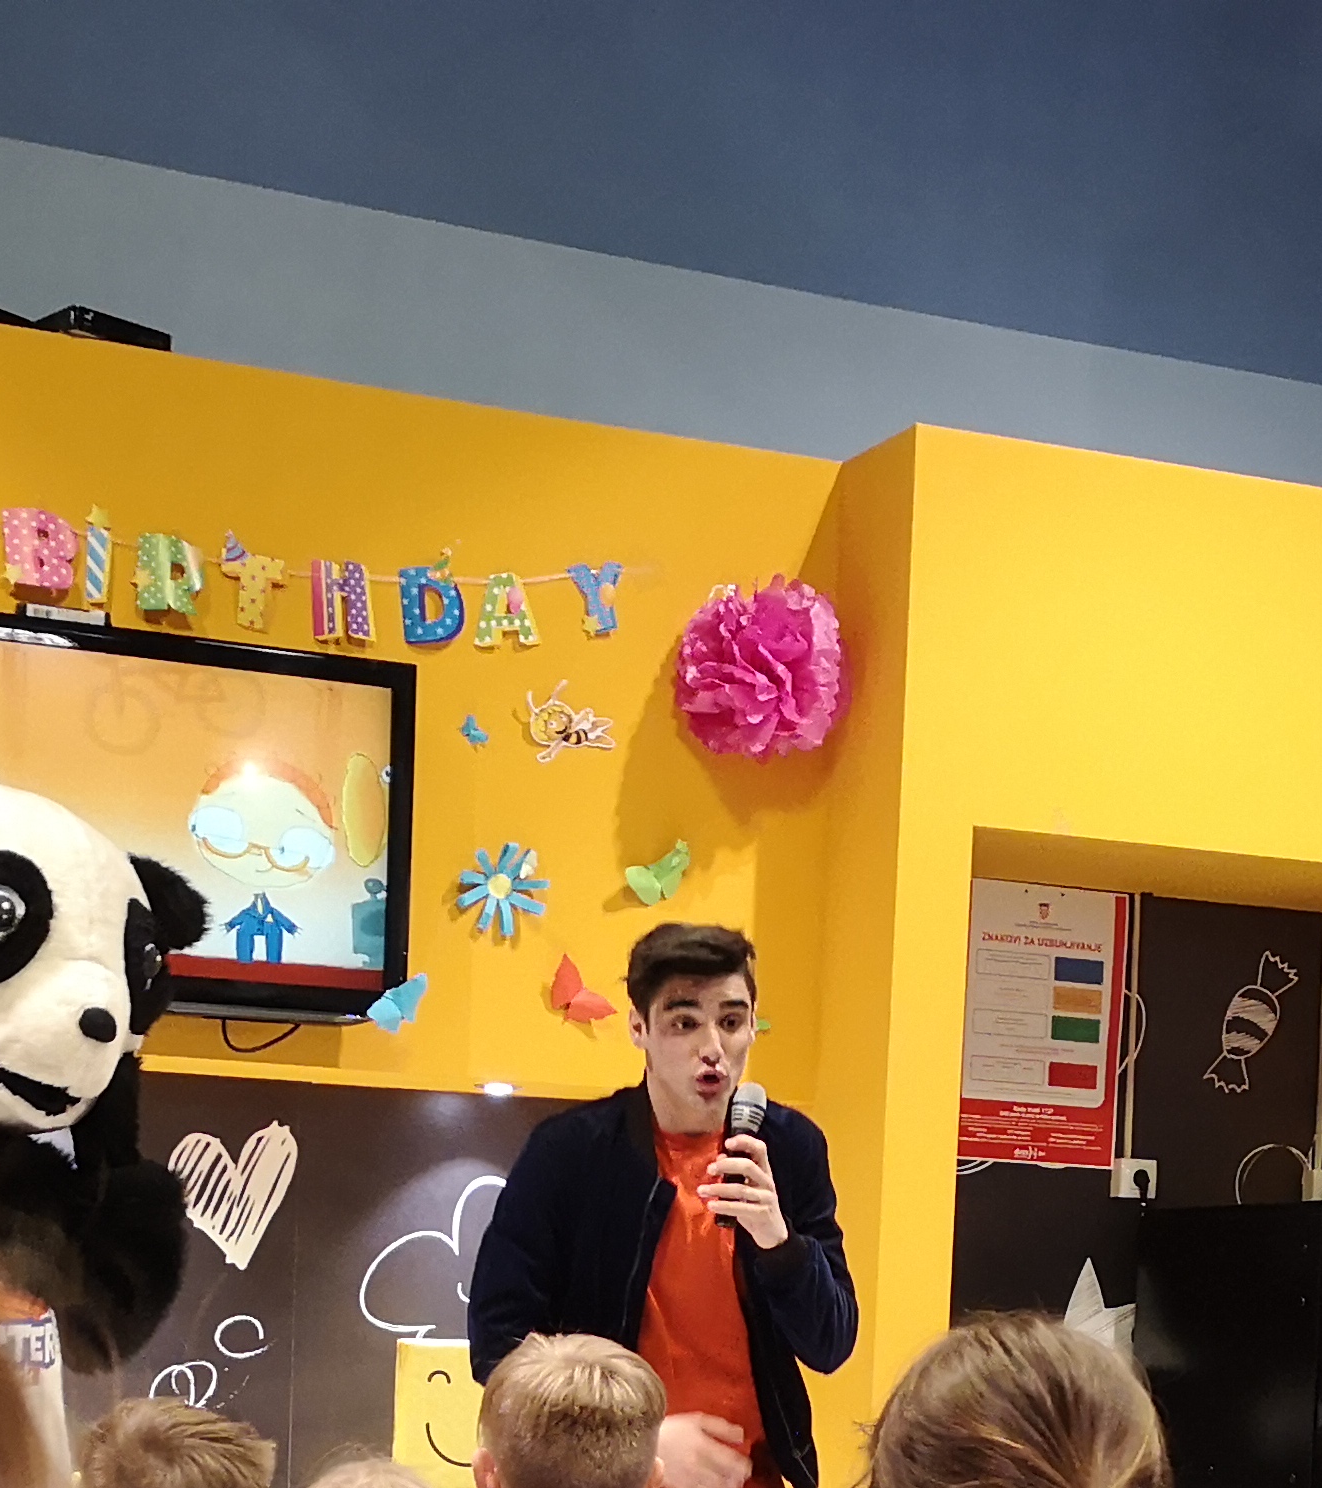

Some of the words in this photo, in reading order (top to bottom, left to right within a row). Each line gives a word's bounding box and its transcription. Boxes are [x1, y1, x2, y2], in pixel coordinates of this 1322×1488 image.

[0, 503, 624, 650] BIRTHDAY
[981, 931, 1021, 946] ZNAKOVI
[1023, 935, 1035, 946] ZA
